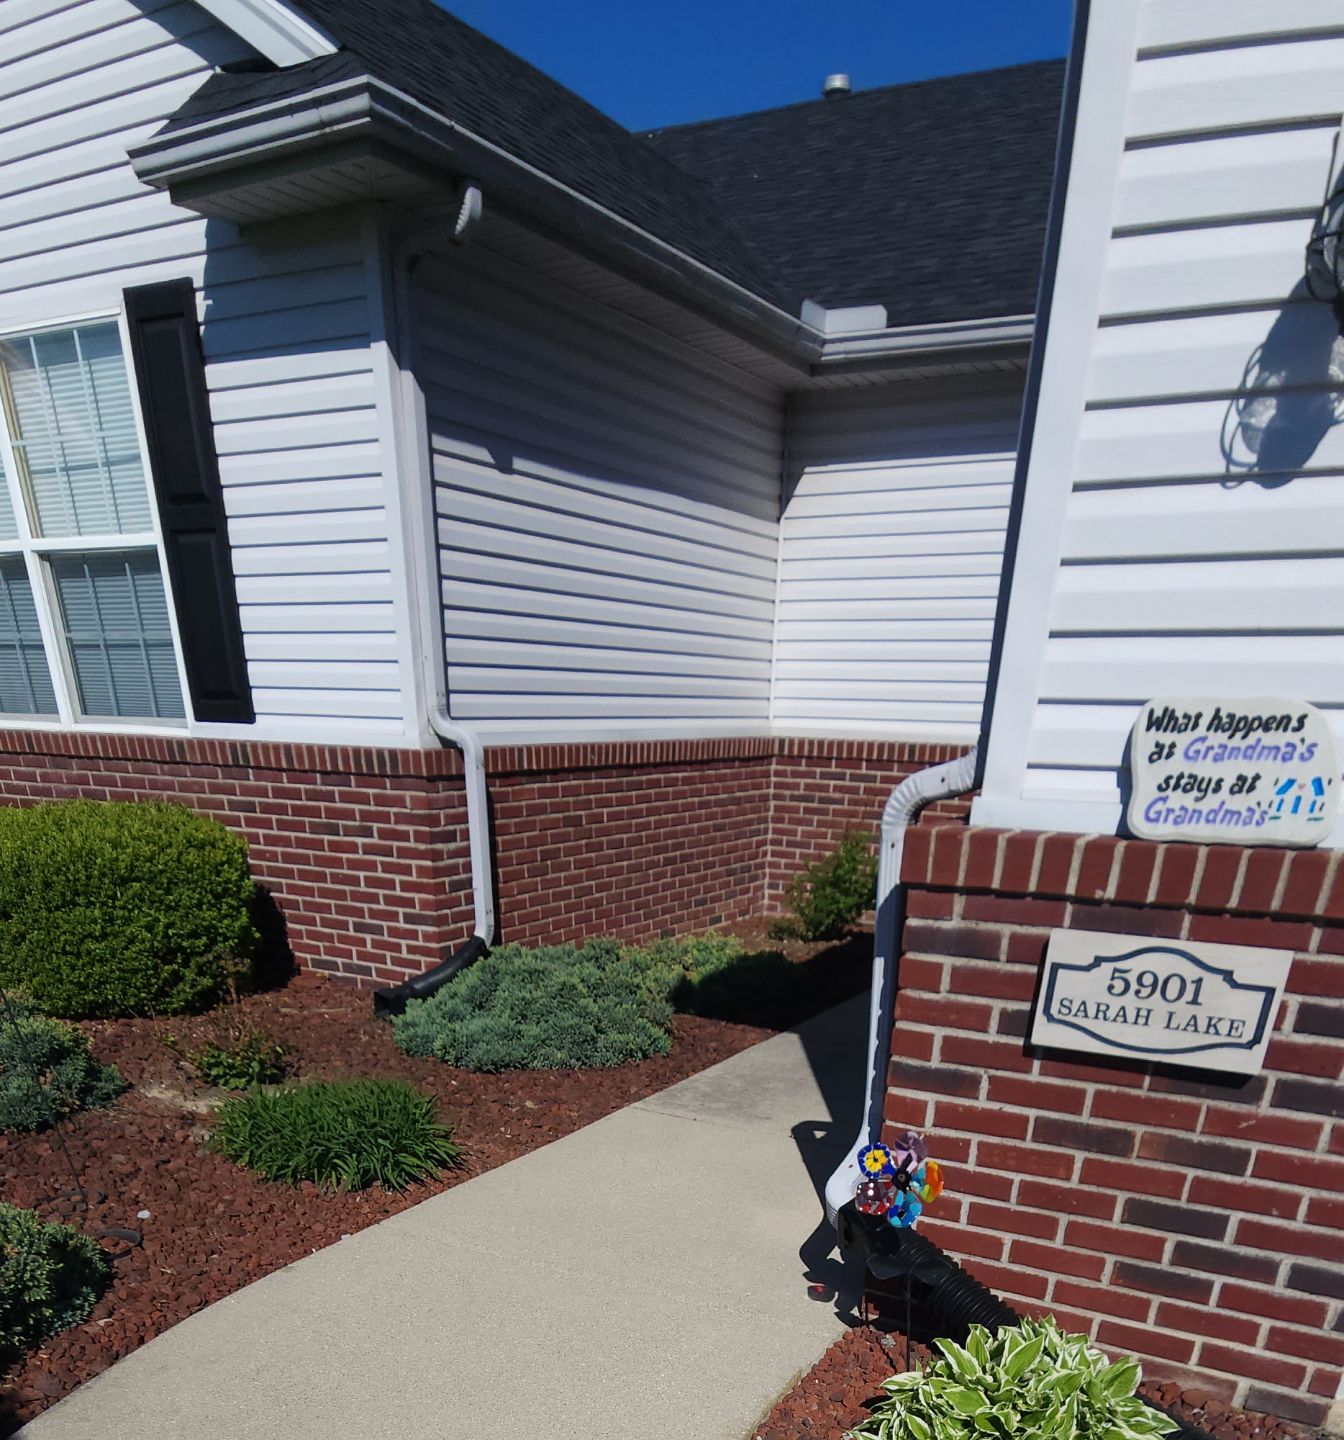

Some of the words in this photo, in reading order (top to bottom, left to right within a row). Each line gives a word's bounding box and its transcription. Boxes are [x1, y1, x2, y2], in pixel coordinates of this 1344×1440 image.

[1145, 706, 1203, 734] What
[1206, 707, 1308, 740] happens
[1148, 740, 1177, 763] at
[1183, 736, 1318, 763] Grandma's
[1157, 771, 1224, 802] stays
[1229, 773, 1262, 795] at
[1144, 795, 1268, 827] Grandma's
[1106, 967, 1204, 1006] 5901
[1057, 998, 1153, 1027] SARAH
[1163, 1011, 1246, 1039] LAKE
